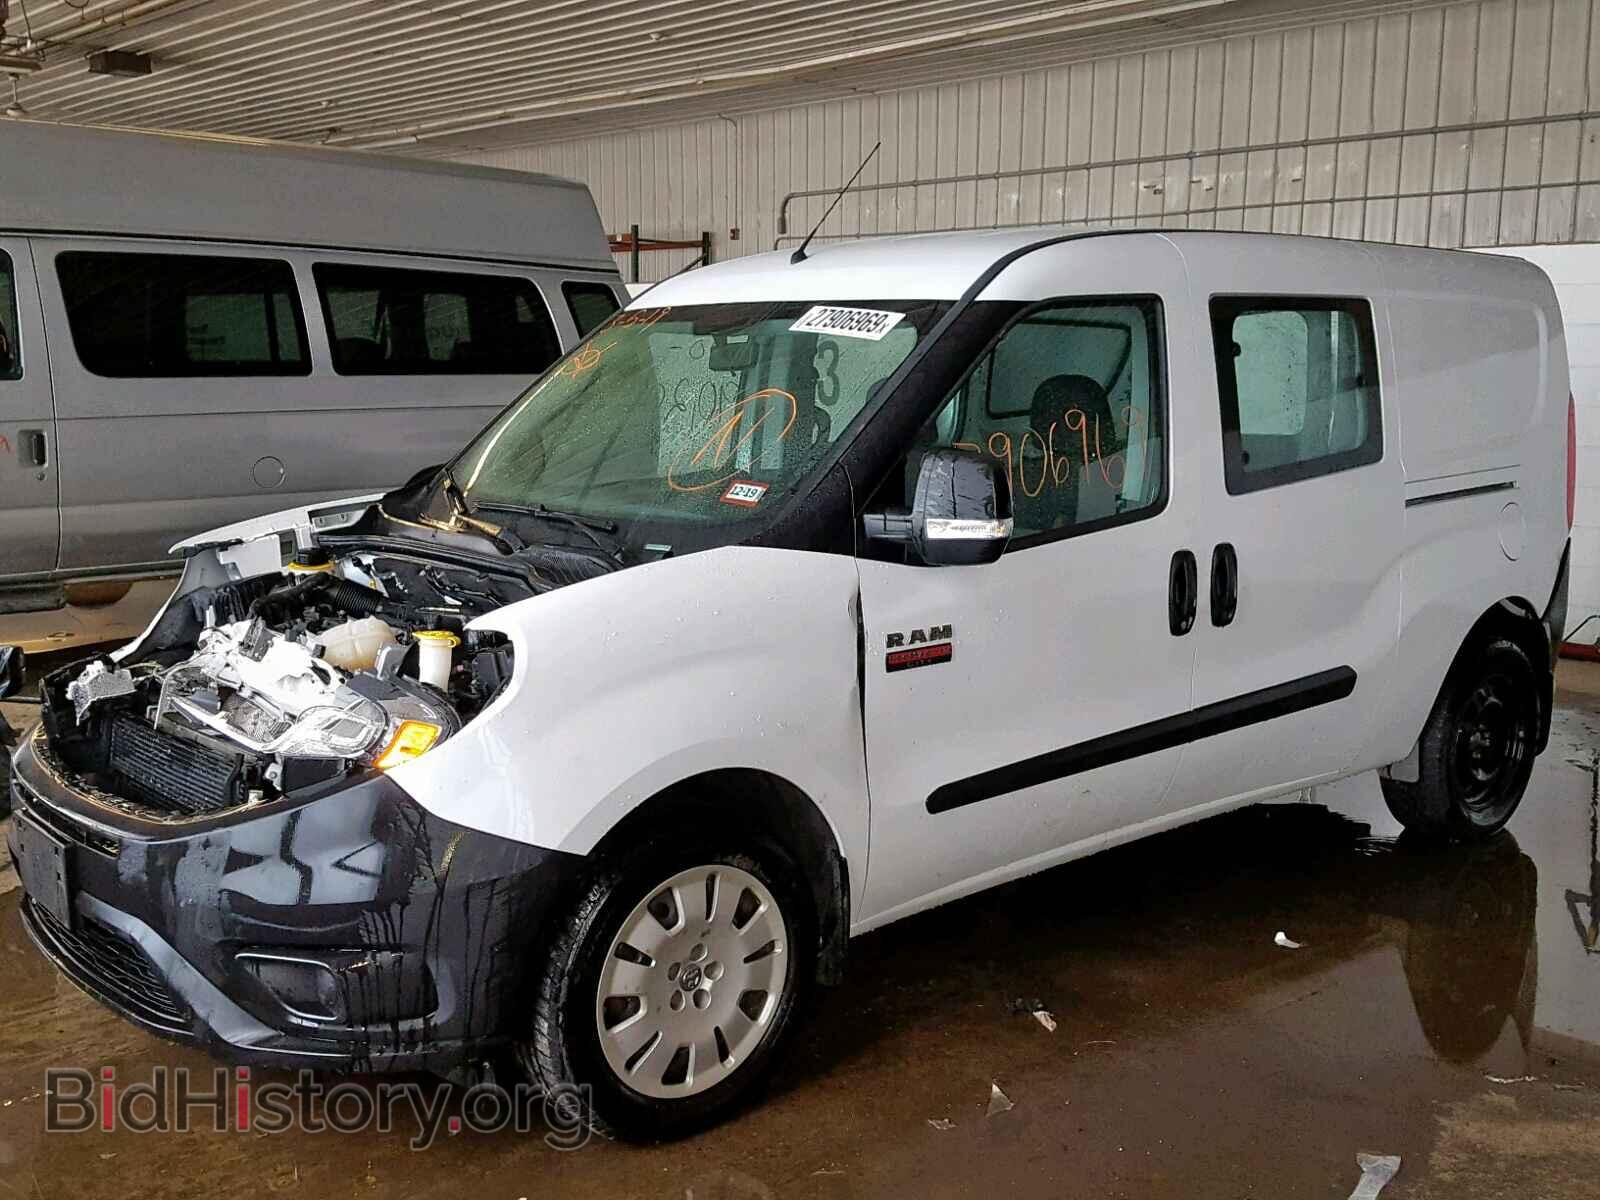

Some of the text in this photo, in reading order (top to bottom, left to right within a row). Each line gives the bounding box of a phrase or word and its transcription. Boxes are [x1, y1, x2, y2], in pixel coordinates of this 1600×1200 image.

[806, 307, 889, 333] 27906969
[953, 404, 1148, 506] 906969
[886, 623, 953, 649] RAM
